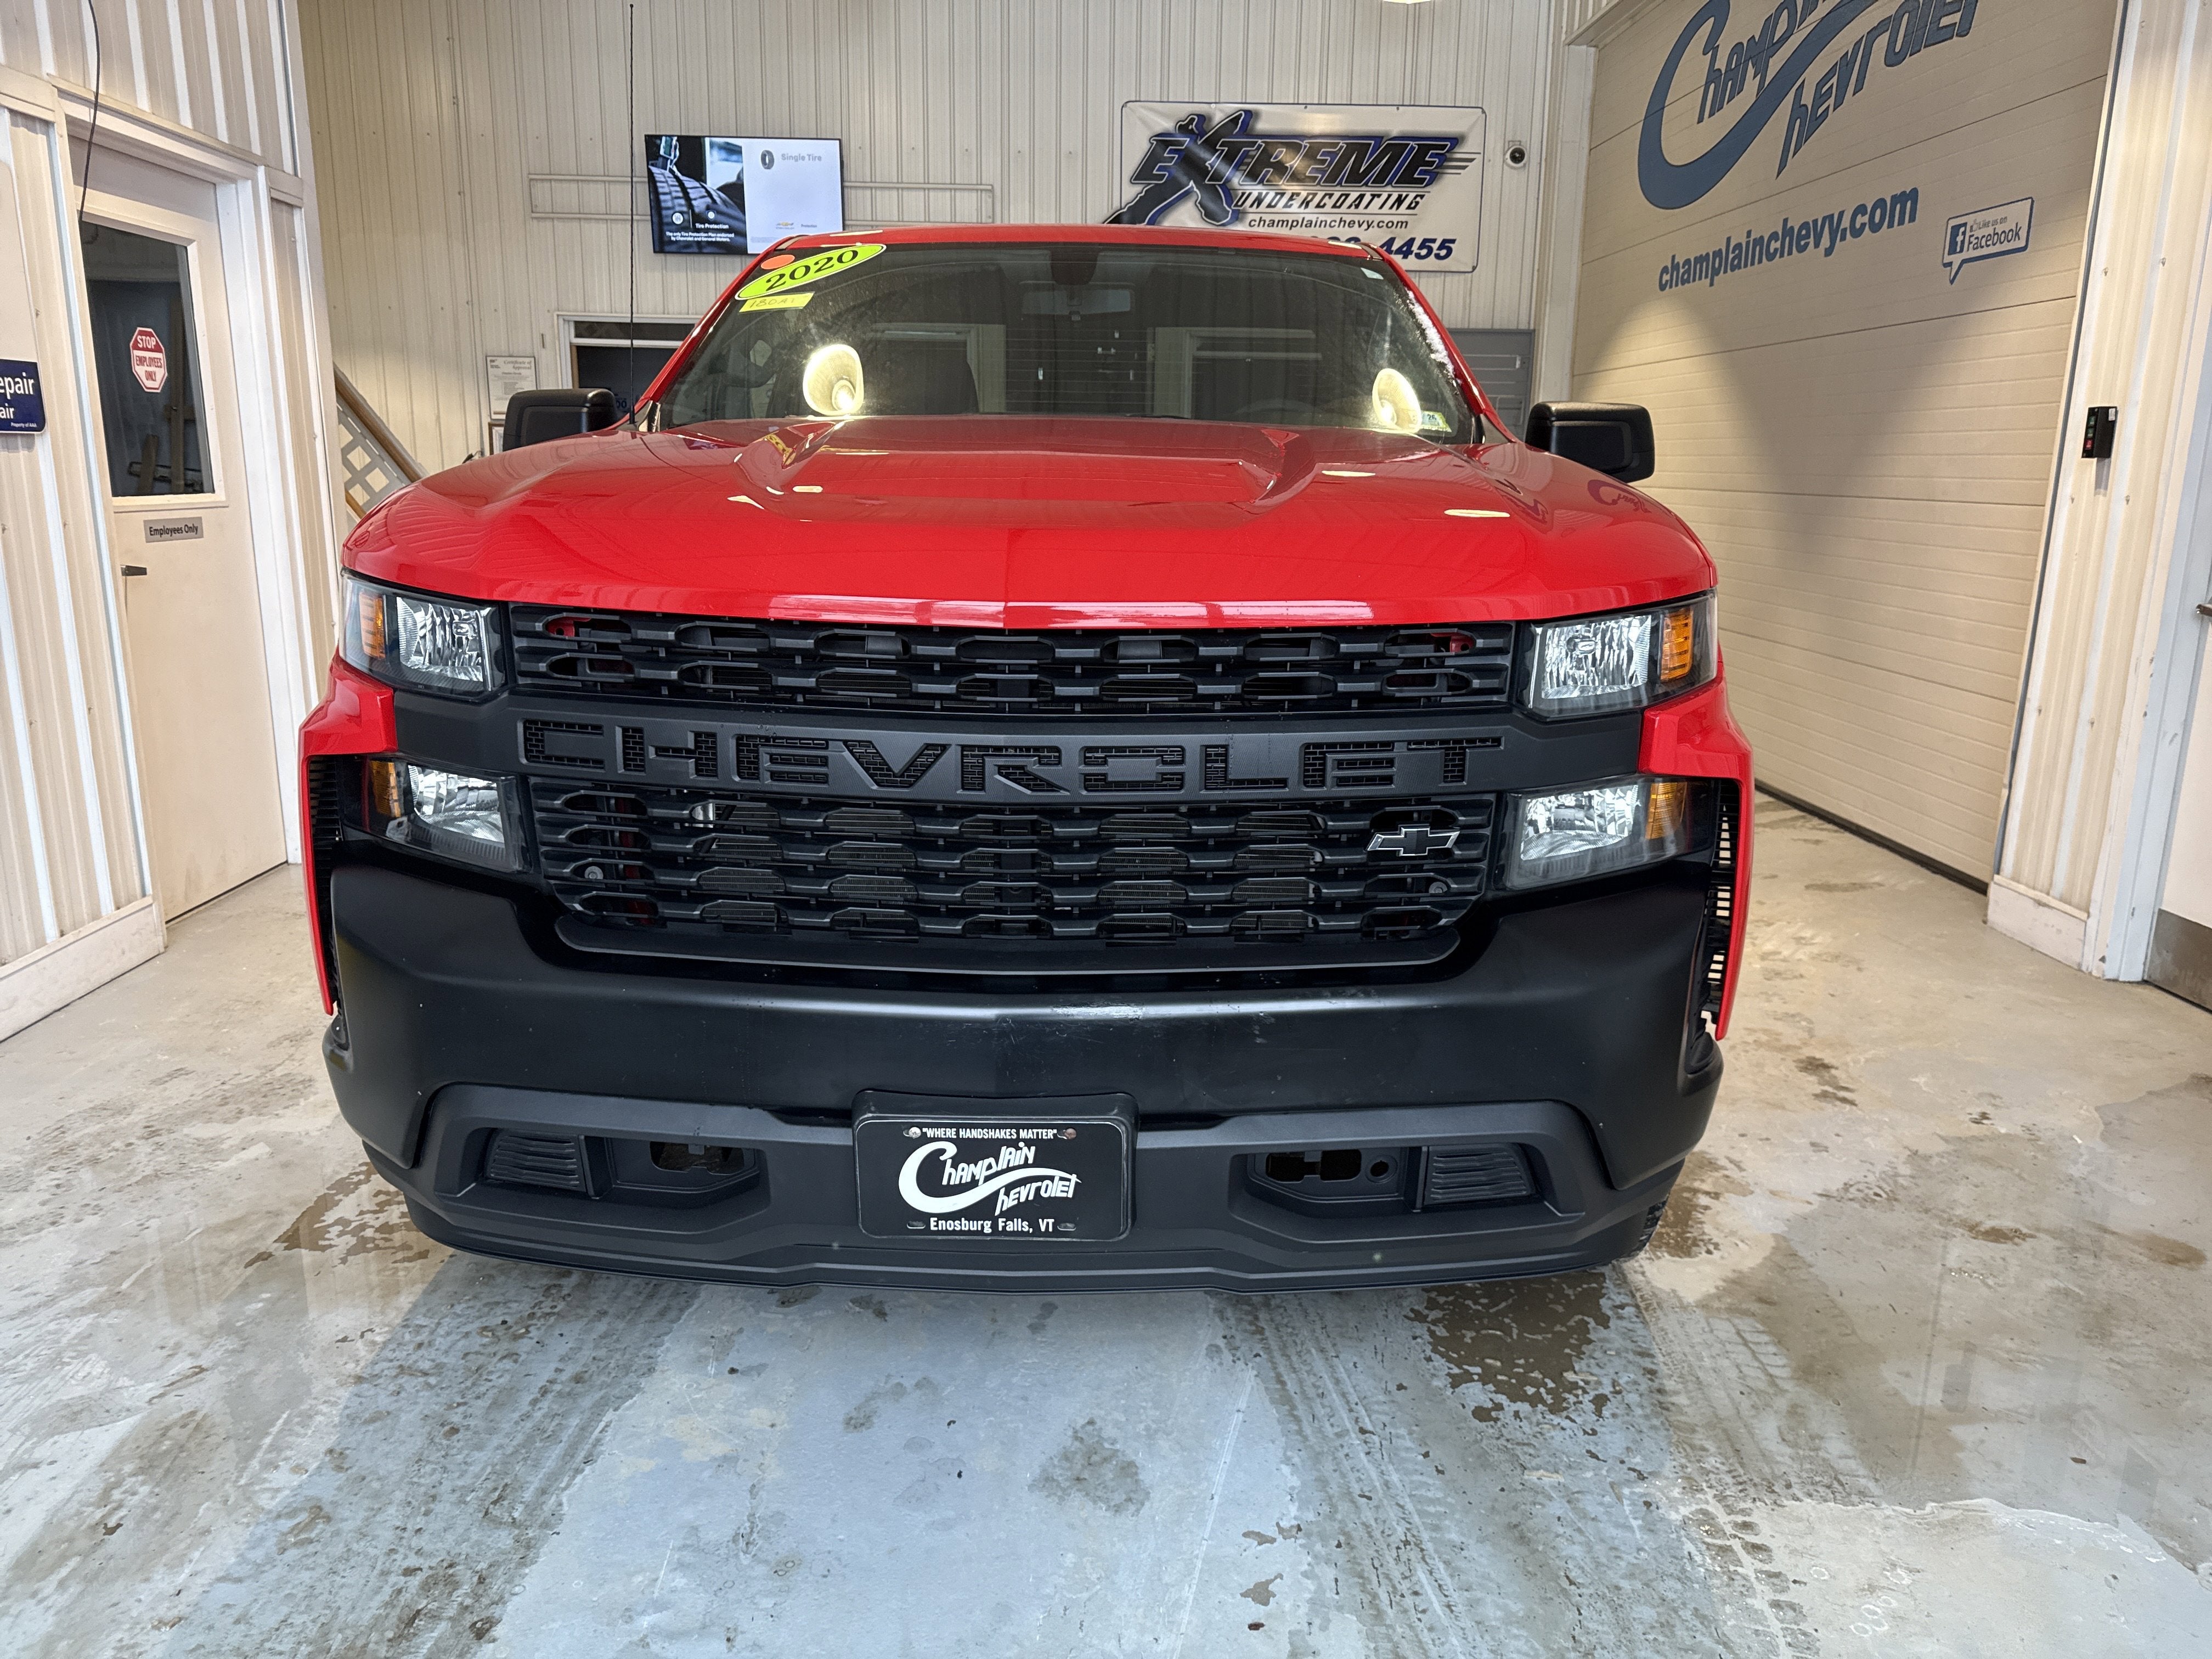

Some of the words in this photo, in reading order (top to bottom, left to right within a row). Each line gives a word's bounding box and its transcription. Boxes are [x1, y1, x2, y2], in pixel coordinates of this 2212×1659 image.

[781, 153, 806, 162] Single
[1103, 109, 1459, 225] EXTREME
[1232, 191, 1426, 210] UNDERCOATING
[1248, 216, 1409, 230] champlainchevy.com
[2000, 216, 2008, 224] on
[1658, 187, 1919, 291] champlainchevy.com
[1967, 222, 2022, 252] Facebook
[766, 250, 859, 291] 2020
[137, 335, 156, 349] STOP
[136, 355, 163, 369] EMPLOYEES
[145, 370, 157, 382] ONLY
[0, 372, 34, 399] epair
[149, 526, 183, 538] Employees
[184, 523, 198, 535] Only
[521, 718, 1504, 794] CHEVROLET
[922, 1127, 957, 1138] "WHERE
[959, 1128, 1017, 1139] HANDSHAKES
[1019, 1128, 1057, 1139] MATTER"
[930, 1217, 992, 1233] Enosburg
[998, 1218, 1033, 1233] Falls,
[1039, 1218, 1054, 1232] VT
